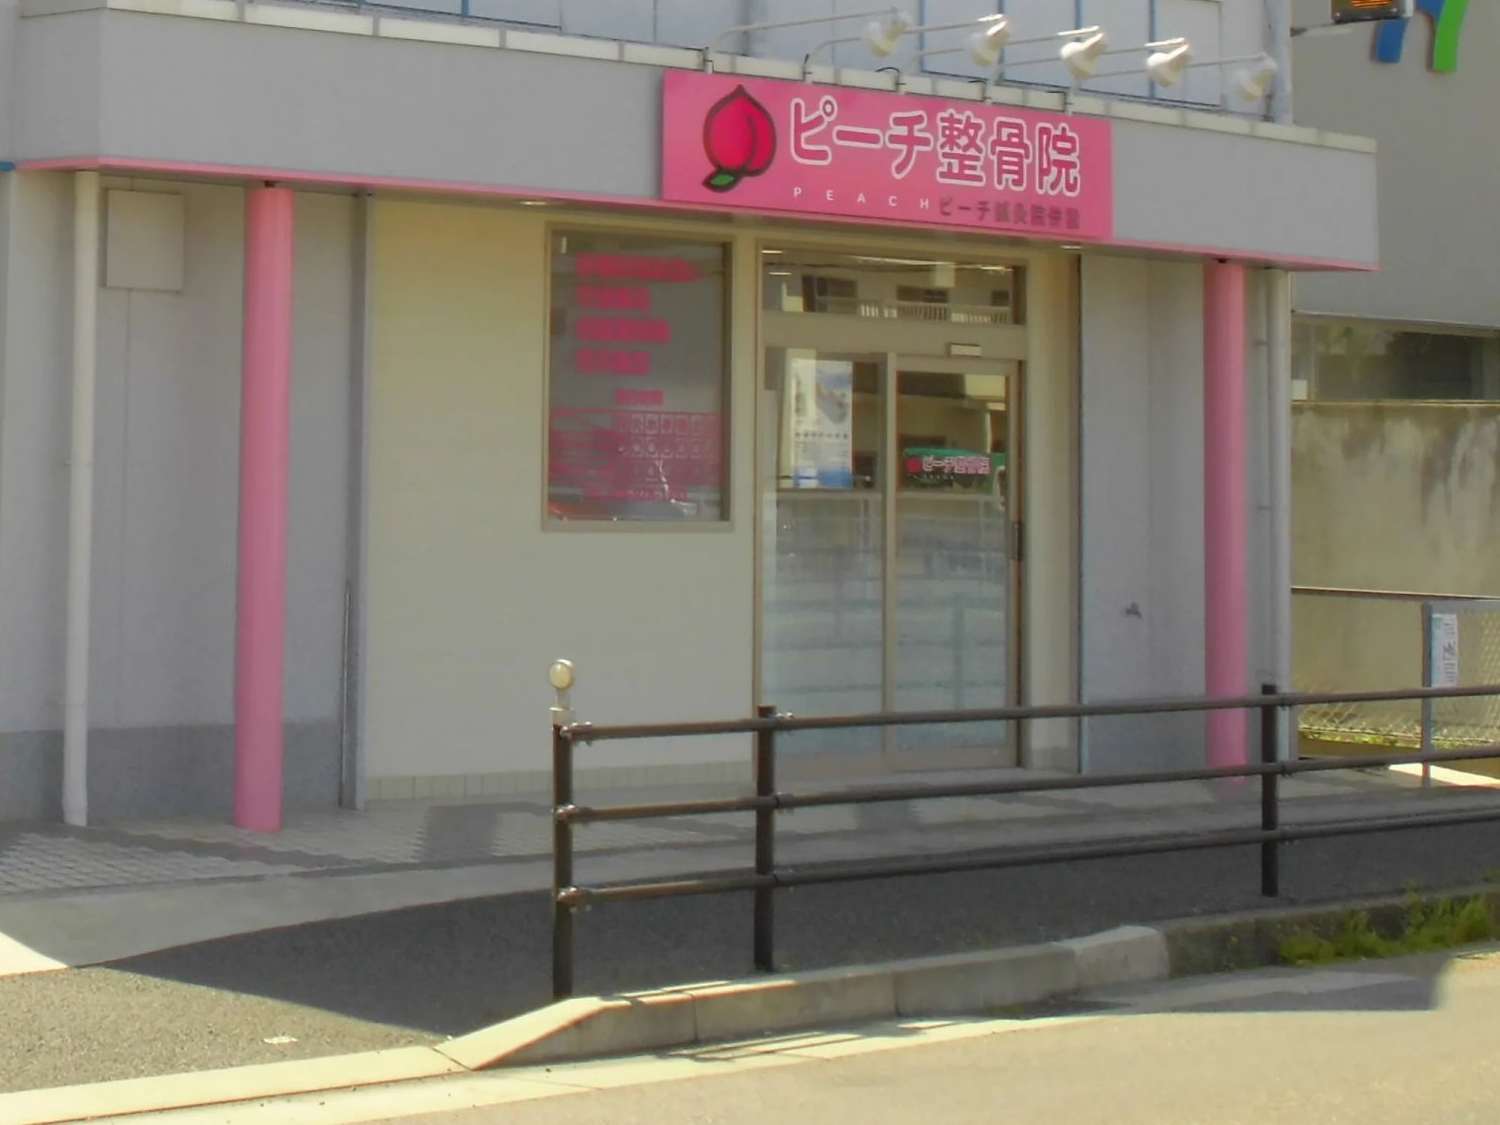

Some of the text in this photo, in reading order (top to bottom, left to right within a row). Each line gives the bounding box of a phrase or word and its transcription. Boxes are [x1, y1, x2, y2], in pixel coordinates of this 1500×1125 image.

[790, 95, 1081, 197] ピーチ整骨院
[793, 187, 930, 210] PEACH
